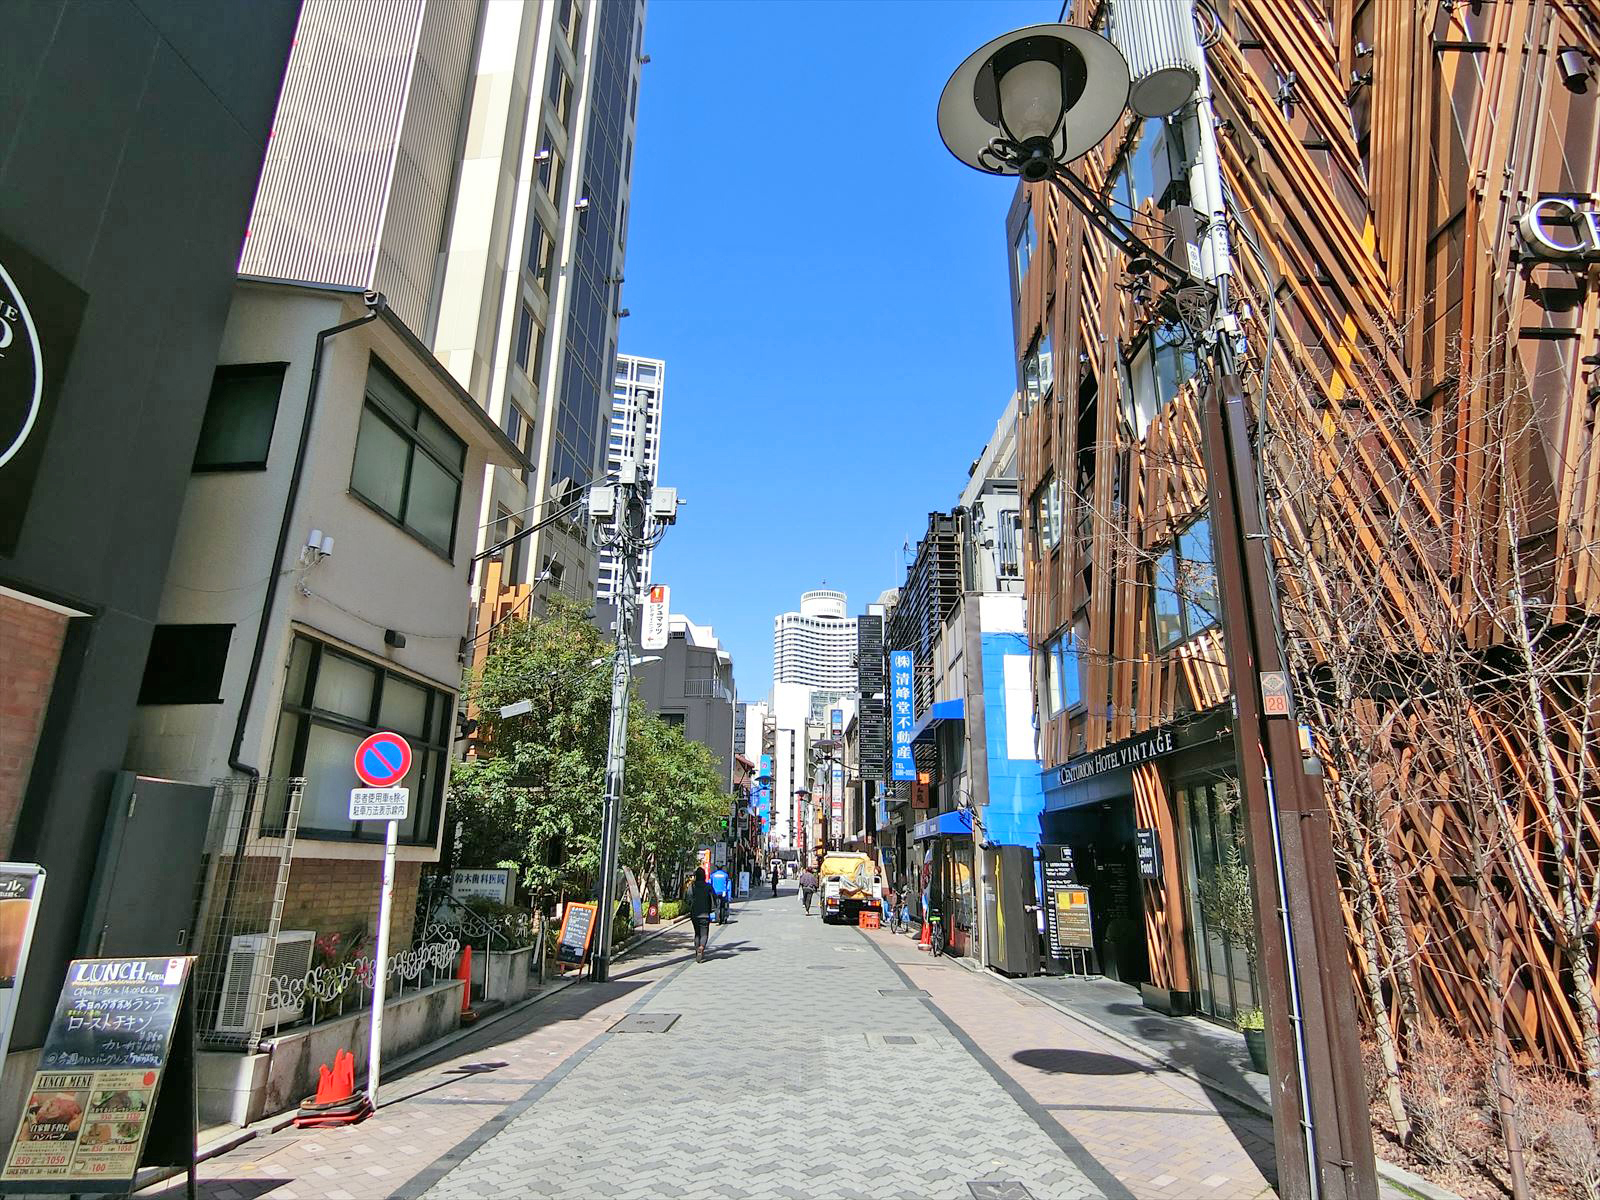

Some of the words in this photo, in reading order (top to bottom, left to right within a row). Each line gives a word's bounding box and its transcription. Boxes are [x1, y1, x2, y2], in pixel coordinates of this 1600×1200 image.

[1268, 697, 1284, 711] 28
[1060, 760, 1095, 785] CENTURION
[1095, 751, 1120, 773] HOTEL
[1121, 733, 1173, 765] VINTAGE
[1137, 845, 1152, 858] Listen
[1140, 860, 1153, 874] Food
[455, 872, 506, 885] 鈴木歯科医院
[76, 961, 146, 982] LUNCH
[75, 997, 165, 1013] 本日のおすすめランチ
[68, 1013, 152, 1033] ローストチキン
[38, 1075, 69, 1088] LUNCH
[32, 1133, 67, 1141] ハンバーグ
[15, 1156, 30, 1165] 850
[47, 1156, 66, 1165] 1050
